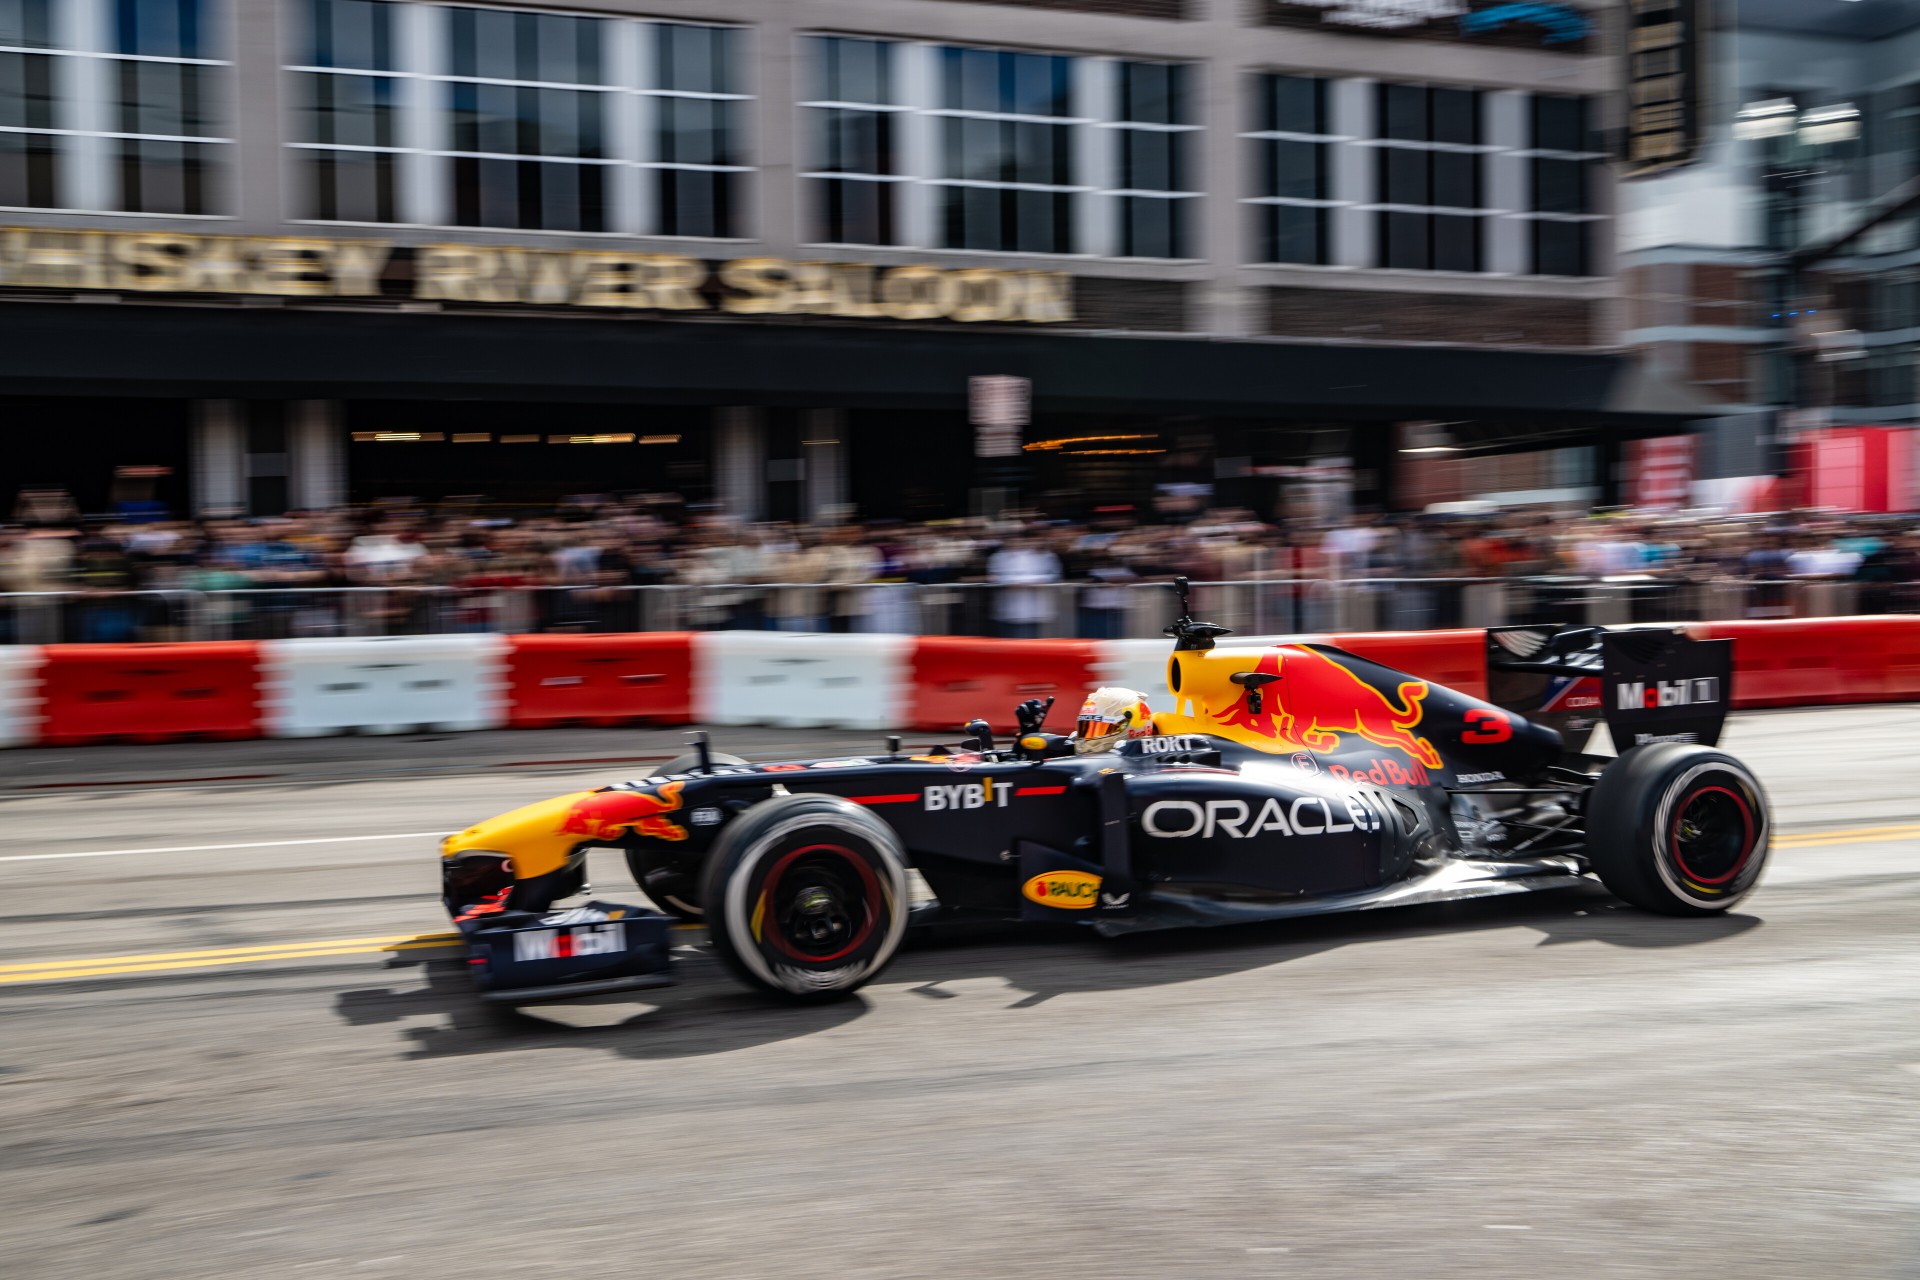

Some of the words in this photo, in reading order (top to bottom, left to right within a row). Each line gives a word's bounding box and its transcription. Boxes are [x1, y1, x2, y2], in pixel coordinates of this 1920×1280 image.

[413, 243, 706, 311] RIVER
[718, 256, 1078, 323] SALOON
[1617, 679, 1692, 710] Mobil
[1692, 677, 1720, 702] 1
[1461, 708, 1513, 744] 3
[1141, 736, 1194, 753] ROKT
[1328, 758, 1389, 786] Red
[1381, 758, 1431, 787] Bull
[1456, 771, 1506, 783] HONDA
[924, 777, 1013, 811] BYBIT
[1141, 796, 1381, 839] ORACLE
[513, 922, 627, 962] Mobil
